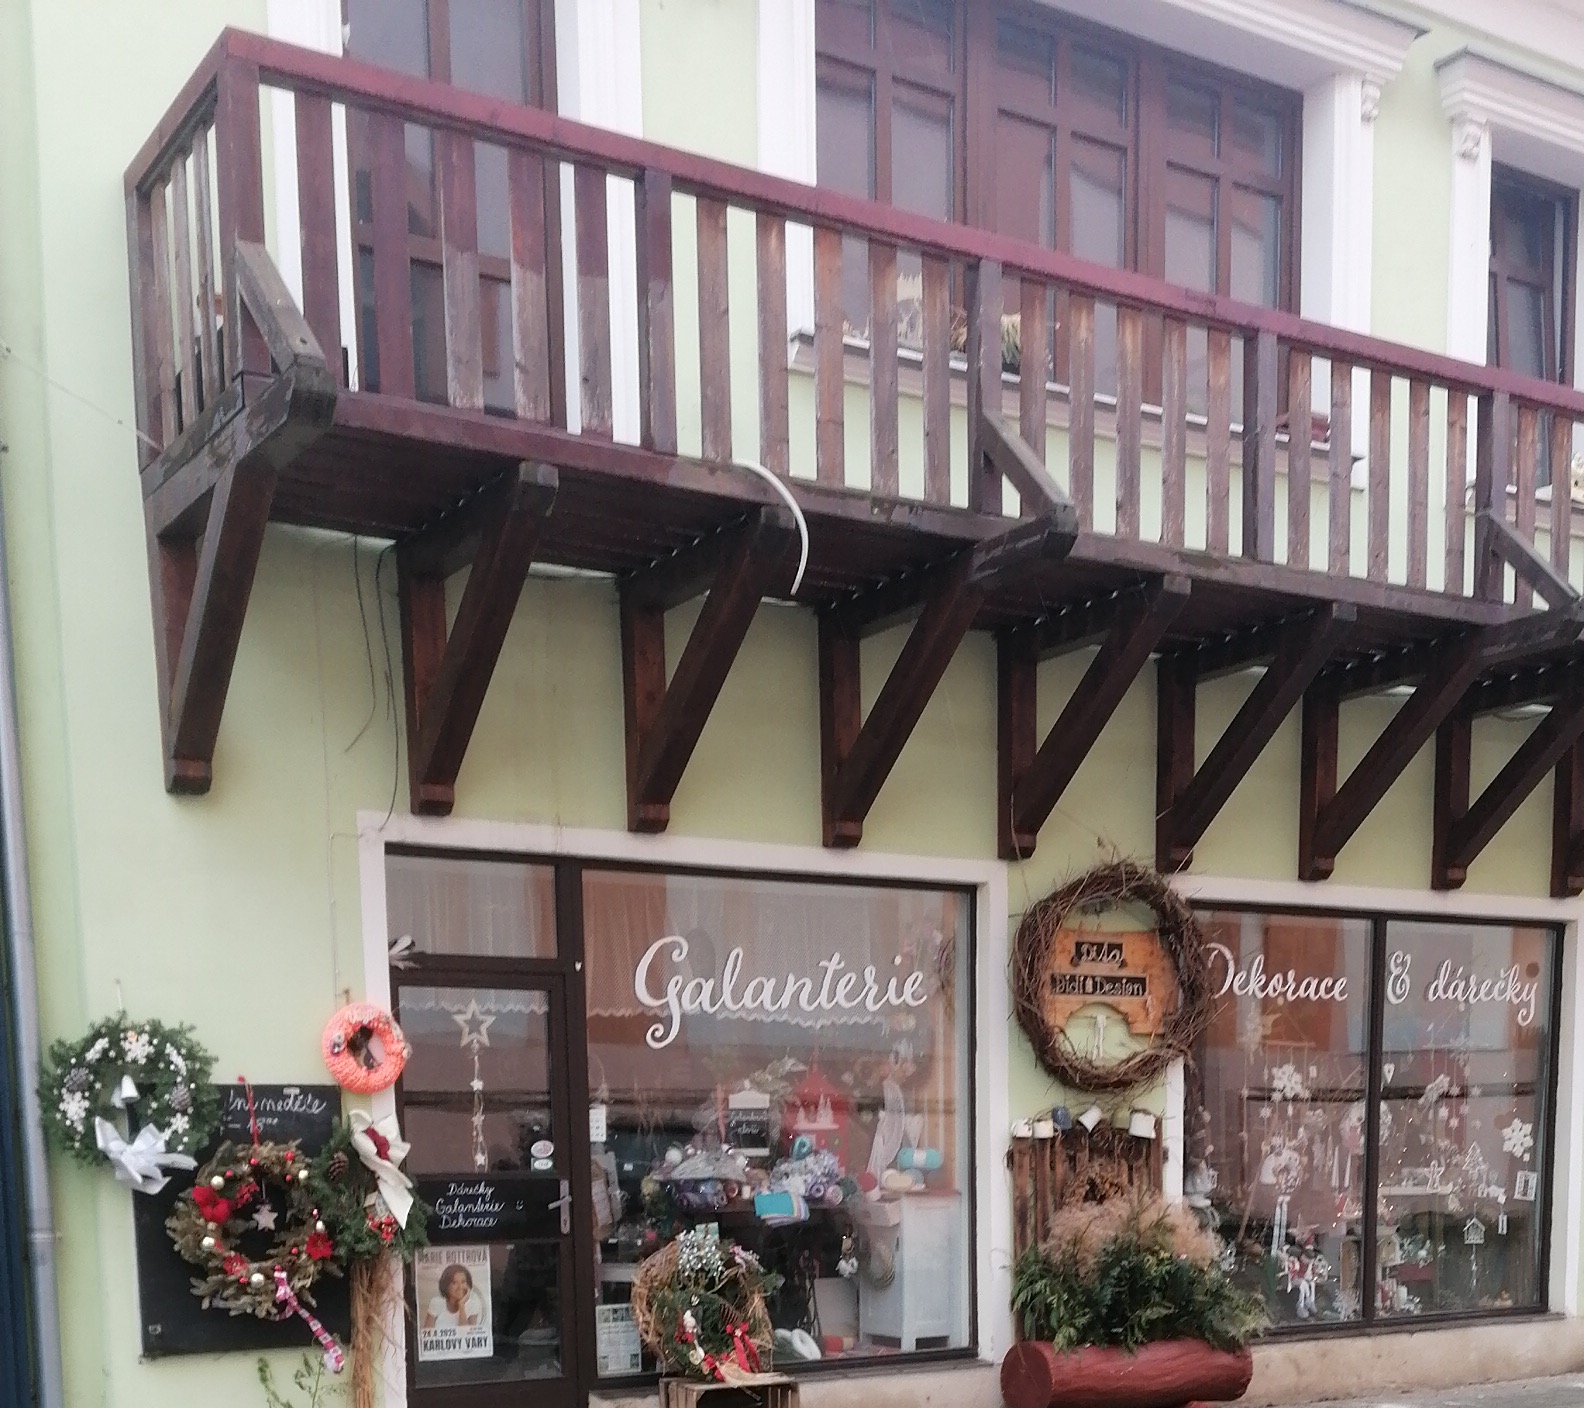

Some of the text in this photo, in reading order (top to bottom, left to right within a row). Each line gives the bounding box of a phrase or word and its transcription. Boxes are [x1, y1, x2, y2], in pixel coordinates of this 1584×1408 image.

[634, 935, 927, 1049] Galanterie
[1204, 943, 1348, 1001] Dekorace
[1428, 959, 1538, 1027] dárečky
[423, 1336, 488, 1352] KARLOVY VARY
